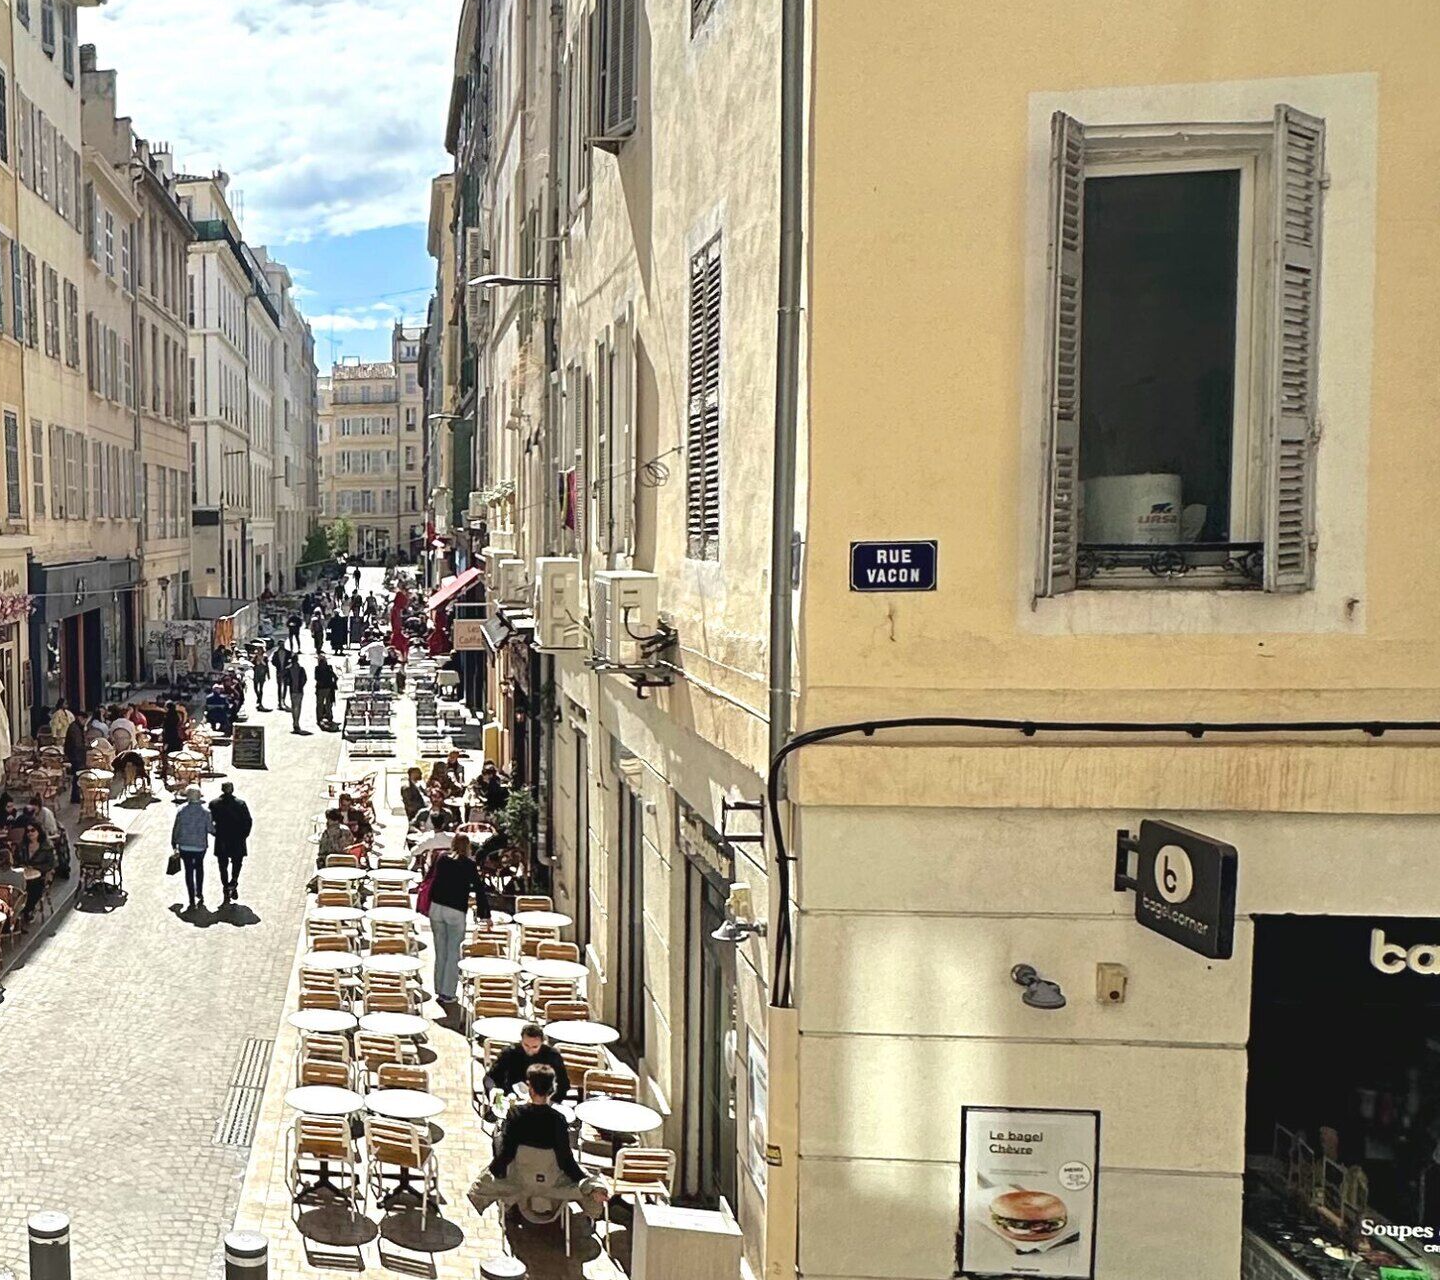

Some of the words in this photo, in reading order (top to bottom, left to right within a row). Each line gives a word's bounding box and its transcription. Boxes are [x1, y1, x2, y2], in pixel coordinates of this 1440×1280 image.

[876, 549, 912, 564] RUE
[866, 568, 920, 583] VACON
[989, 1131, 1004, 1140] Le
[1008, 1131, 1043, 1142] bagel
[989, 1144, 1033, 1155] Chèvre
[1361, 1220, 1434, 1241] Soupes
